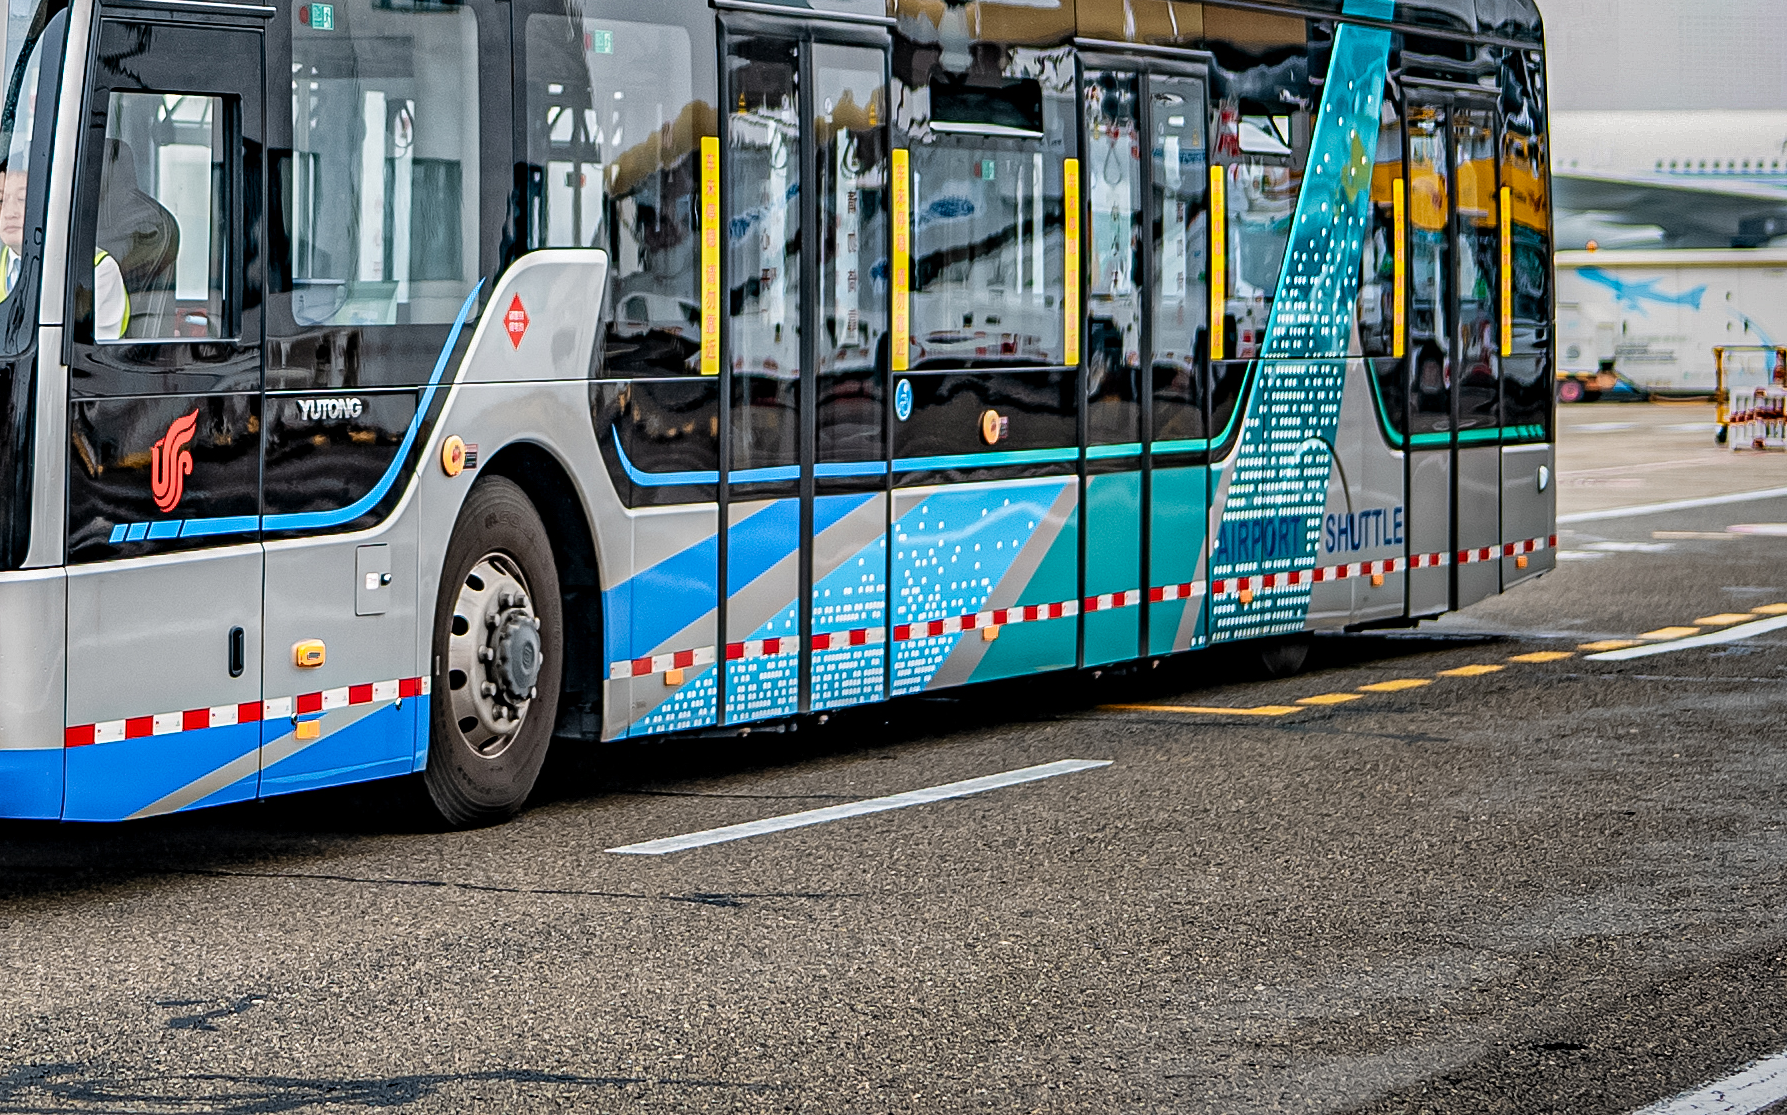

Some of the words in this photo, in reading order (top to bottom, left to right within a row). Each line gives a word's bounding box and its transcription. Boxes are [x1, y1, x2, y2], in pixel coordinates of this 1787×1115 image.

[297, 397, 363, 421] YUTONG
[1216, 516, 1302, 564] AIRPORT
[1325, 506, 1404, 554] SHUTTLE
